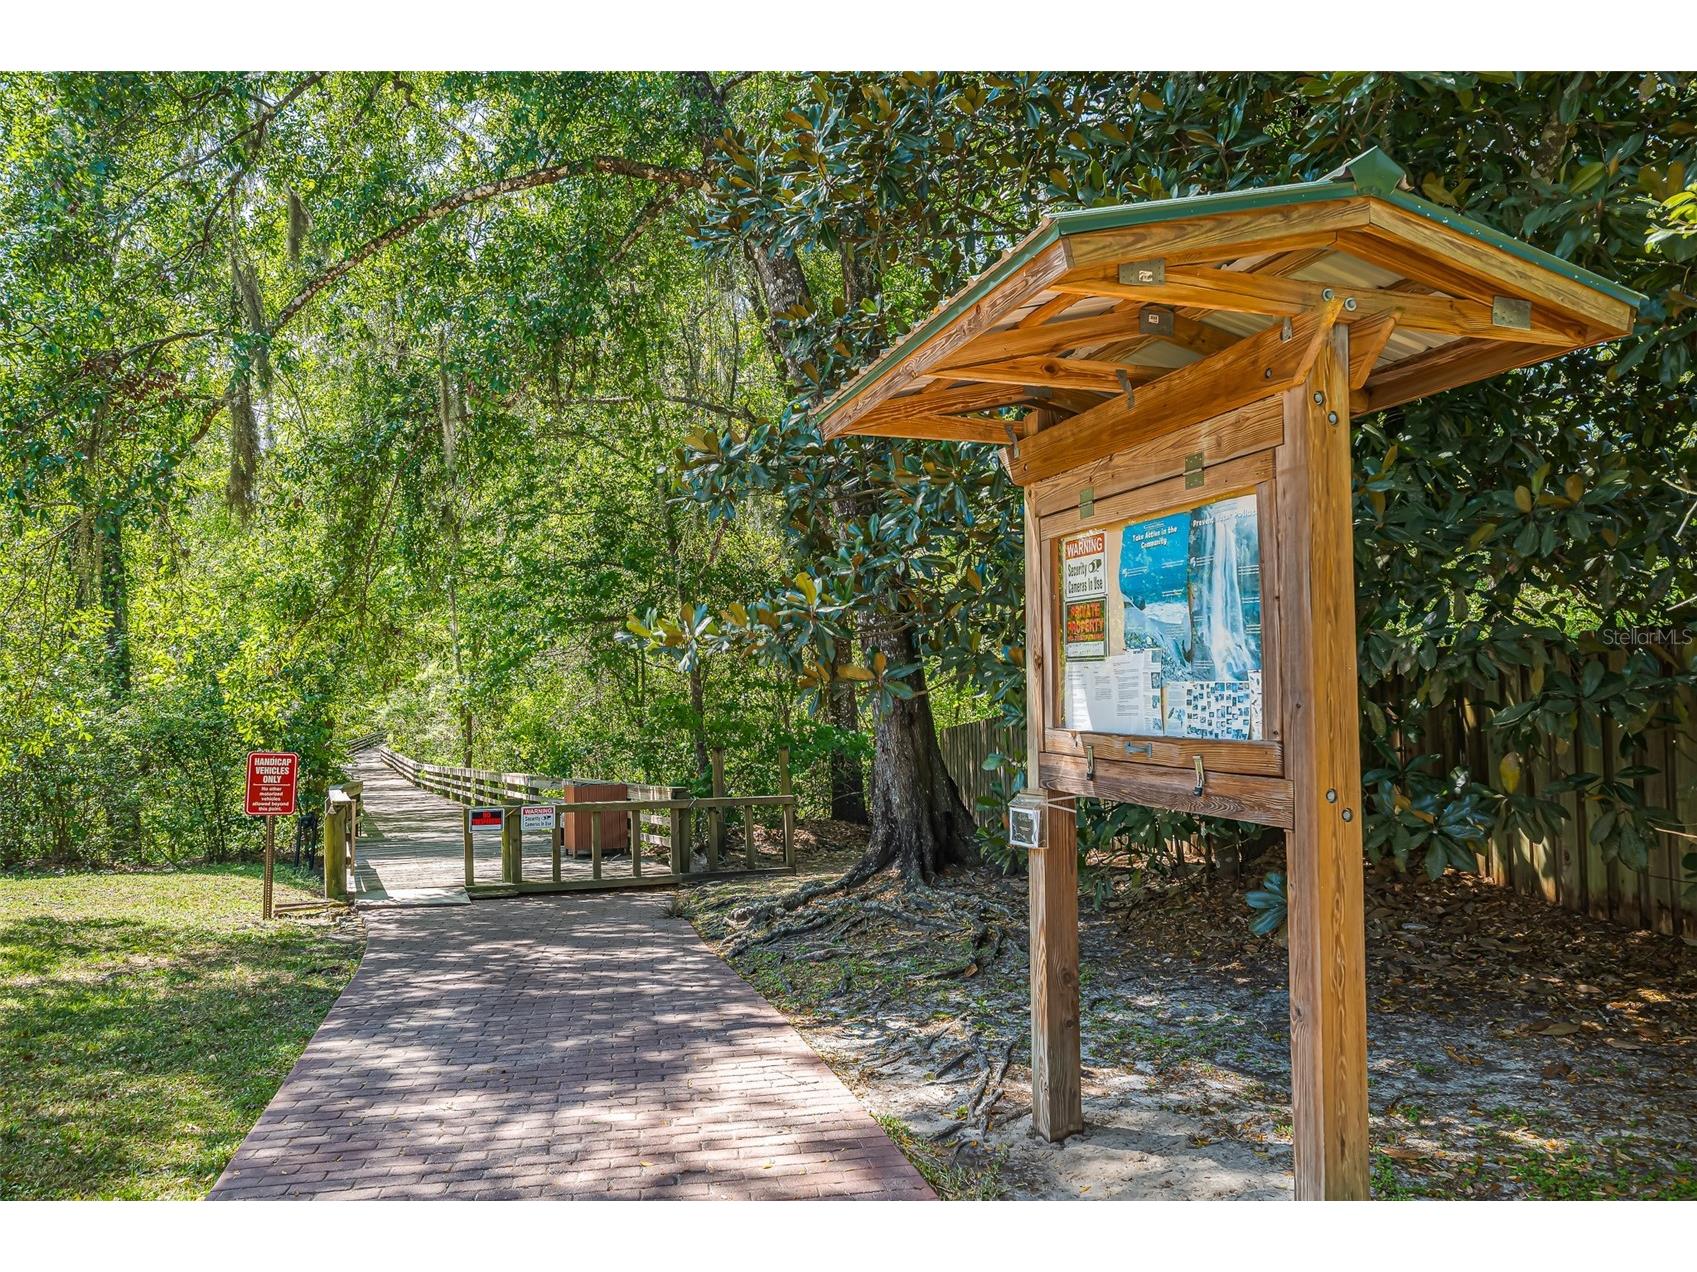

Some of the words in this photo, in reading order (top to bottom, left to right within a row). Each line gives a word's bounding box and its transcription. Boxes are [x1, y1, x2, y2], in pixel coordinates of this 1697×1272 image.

[1066, 537, 1103, 557] WARNING
[1067, 562, 1087, 577] Security
[1068, 580, 1087, 594] Cameras
[1094, 577, 1103, 590] Use
[254, 758, 292, 766] HANDICAP
[255, 767, 290, 775] VEHICLES
[262, 775, 282, 783] ONLY
